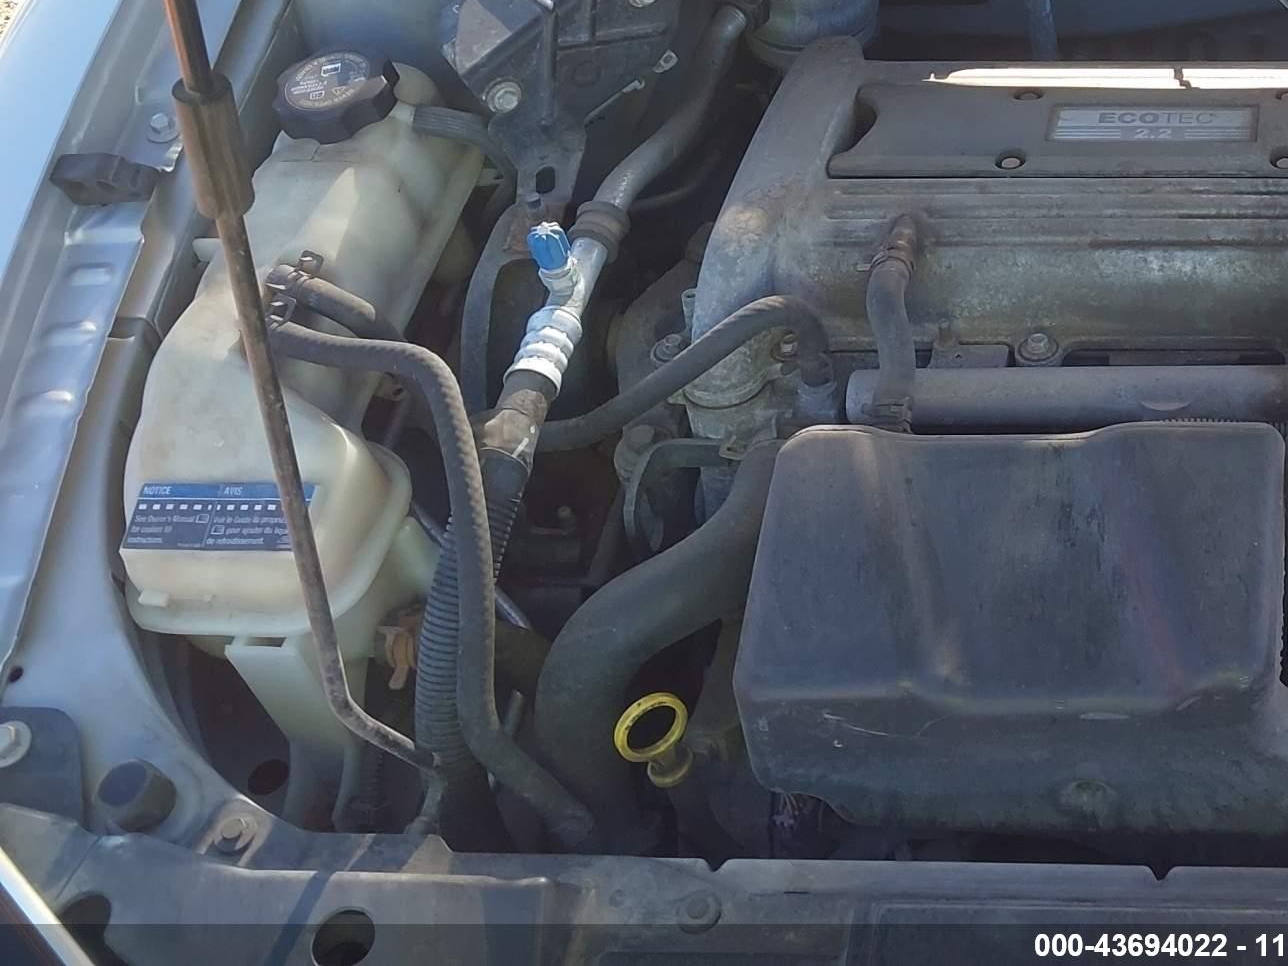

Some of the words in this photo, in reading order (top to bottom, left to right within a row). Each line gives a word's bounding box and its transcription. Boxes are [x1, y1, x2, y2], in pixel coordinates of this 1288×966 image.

[1097, 112, 1214, 125] ECOTEC
[1134, 129, 1172, 140] 2.2
[143, 486, 172, 495] NOTICE
[224, 487, 243, 495] AVIS
